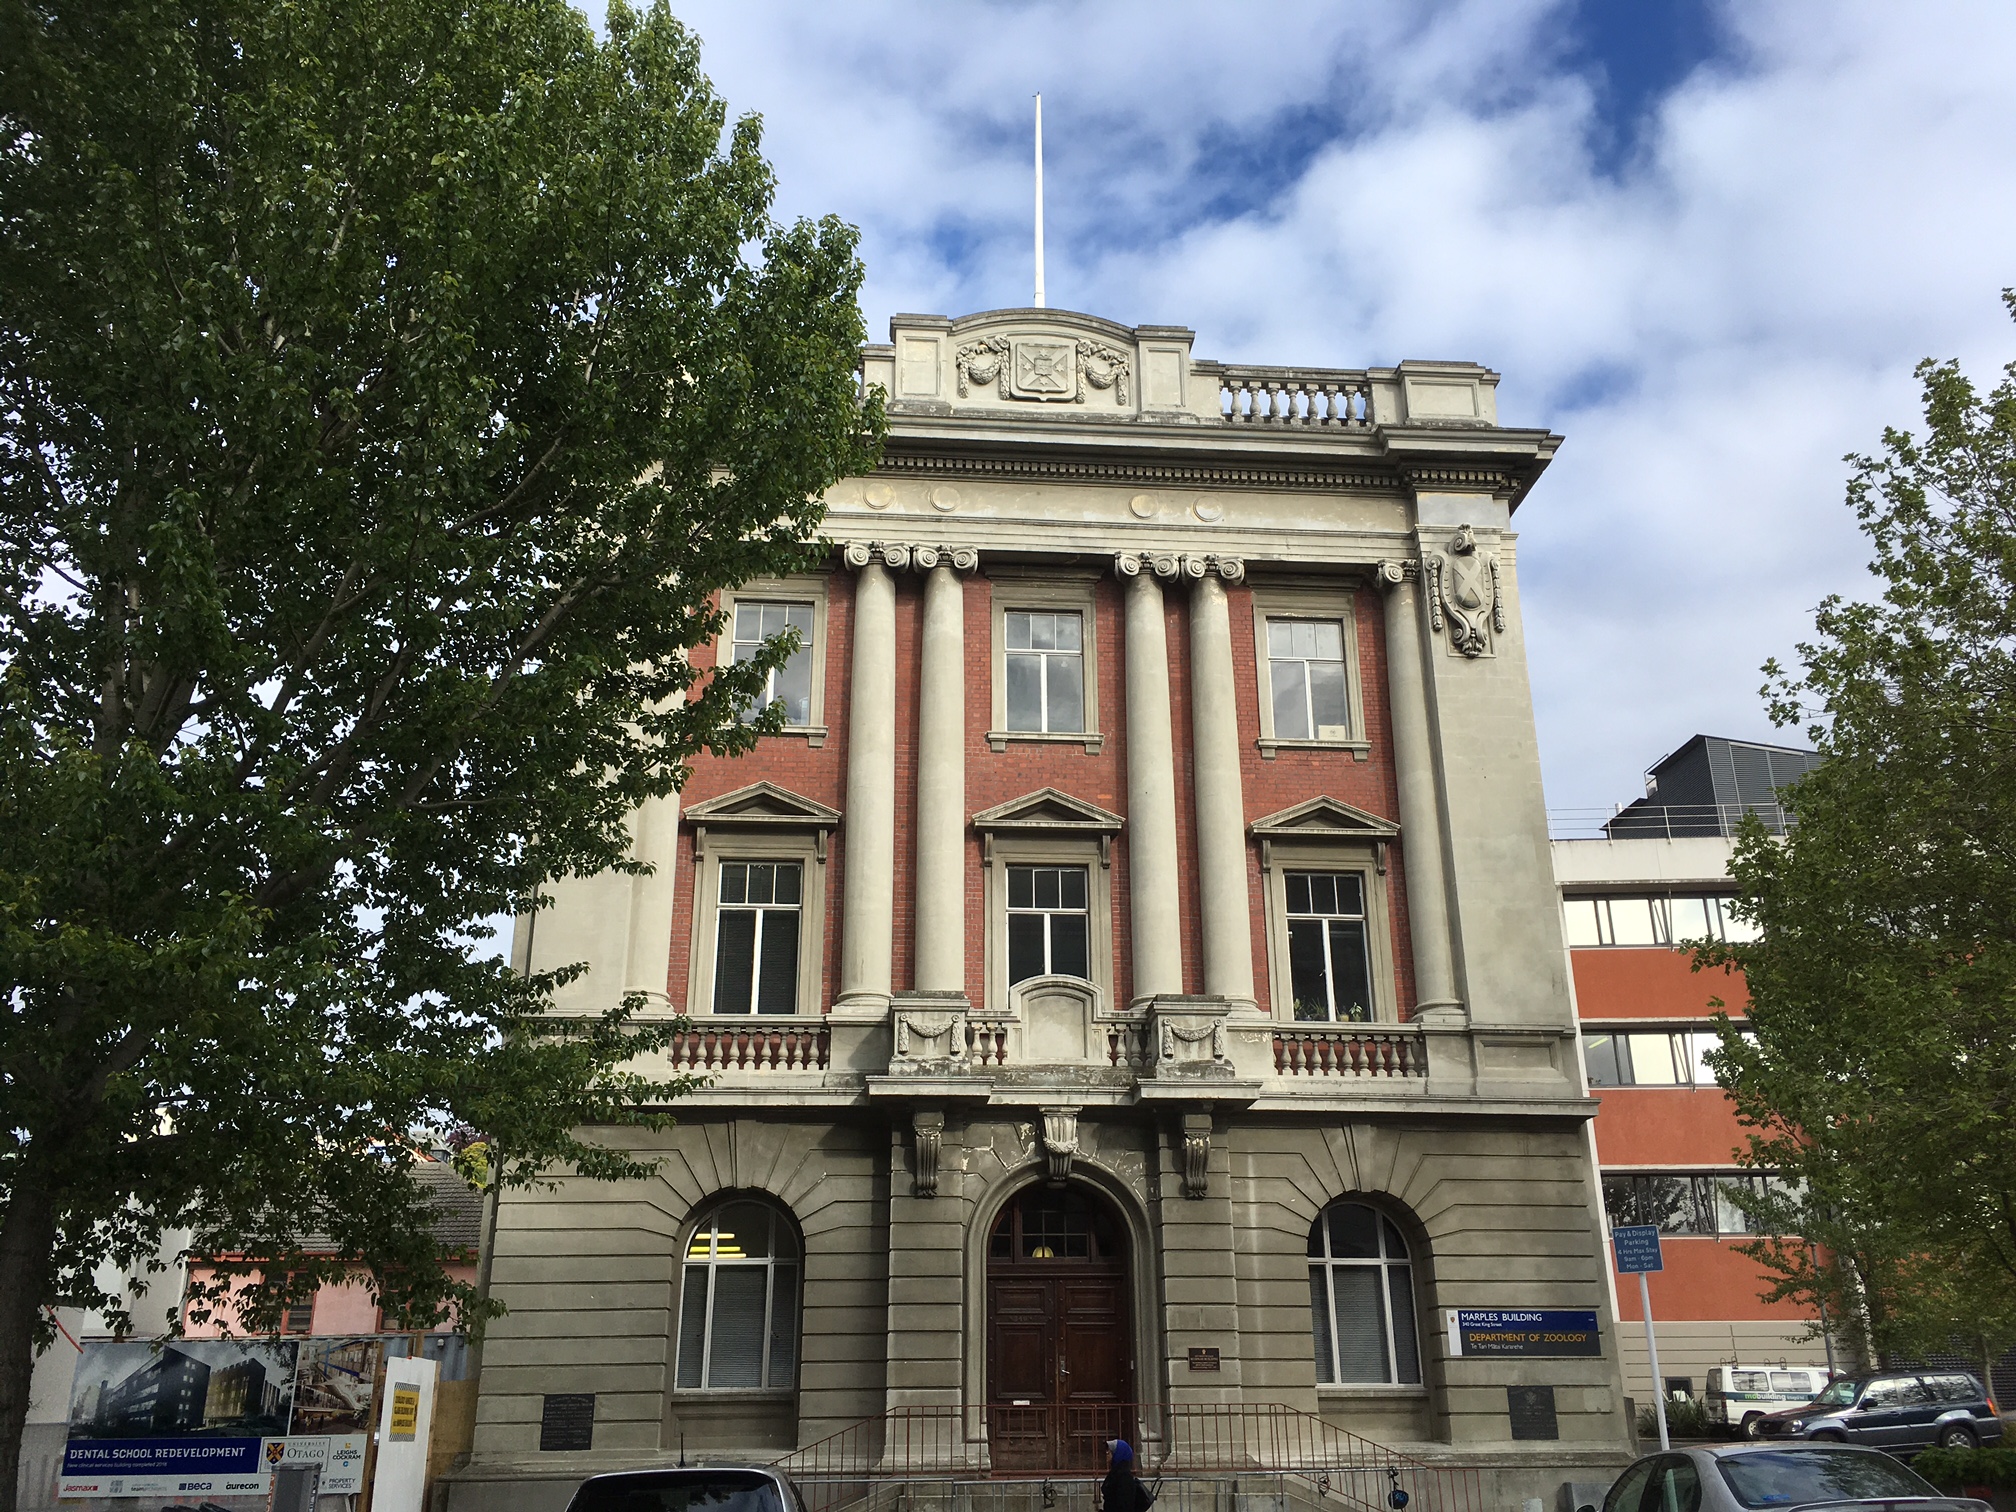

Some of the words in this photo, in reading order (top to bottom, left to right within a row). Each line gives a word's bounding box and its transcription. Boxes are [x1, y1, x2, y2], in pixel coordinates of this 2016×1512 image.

[1461, 1313, 1499, 1321] MARPLES
[1502, 1313, 1543, 1322] BUILDING
[1469, 1333, 1526, 1342] DEPARTMENT
[1529, 1333, 1540, 1342] OF
[1543, 1333, 1587, 1342] ZOOLOGY
[70, 1449, 110, 1459] DENTAL
[112, 1448, 152, 1459] SCHOOL
[155, 1447, 246, 1458] REDEVELOPMENT
[287, 1447, 325, 1459] OTAGO
[225, 1482, 259, 1490] aurecon
